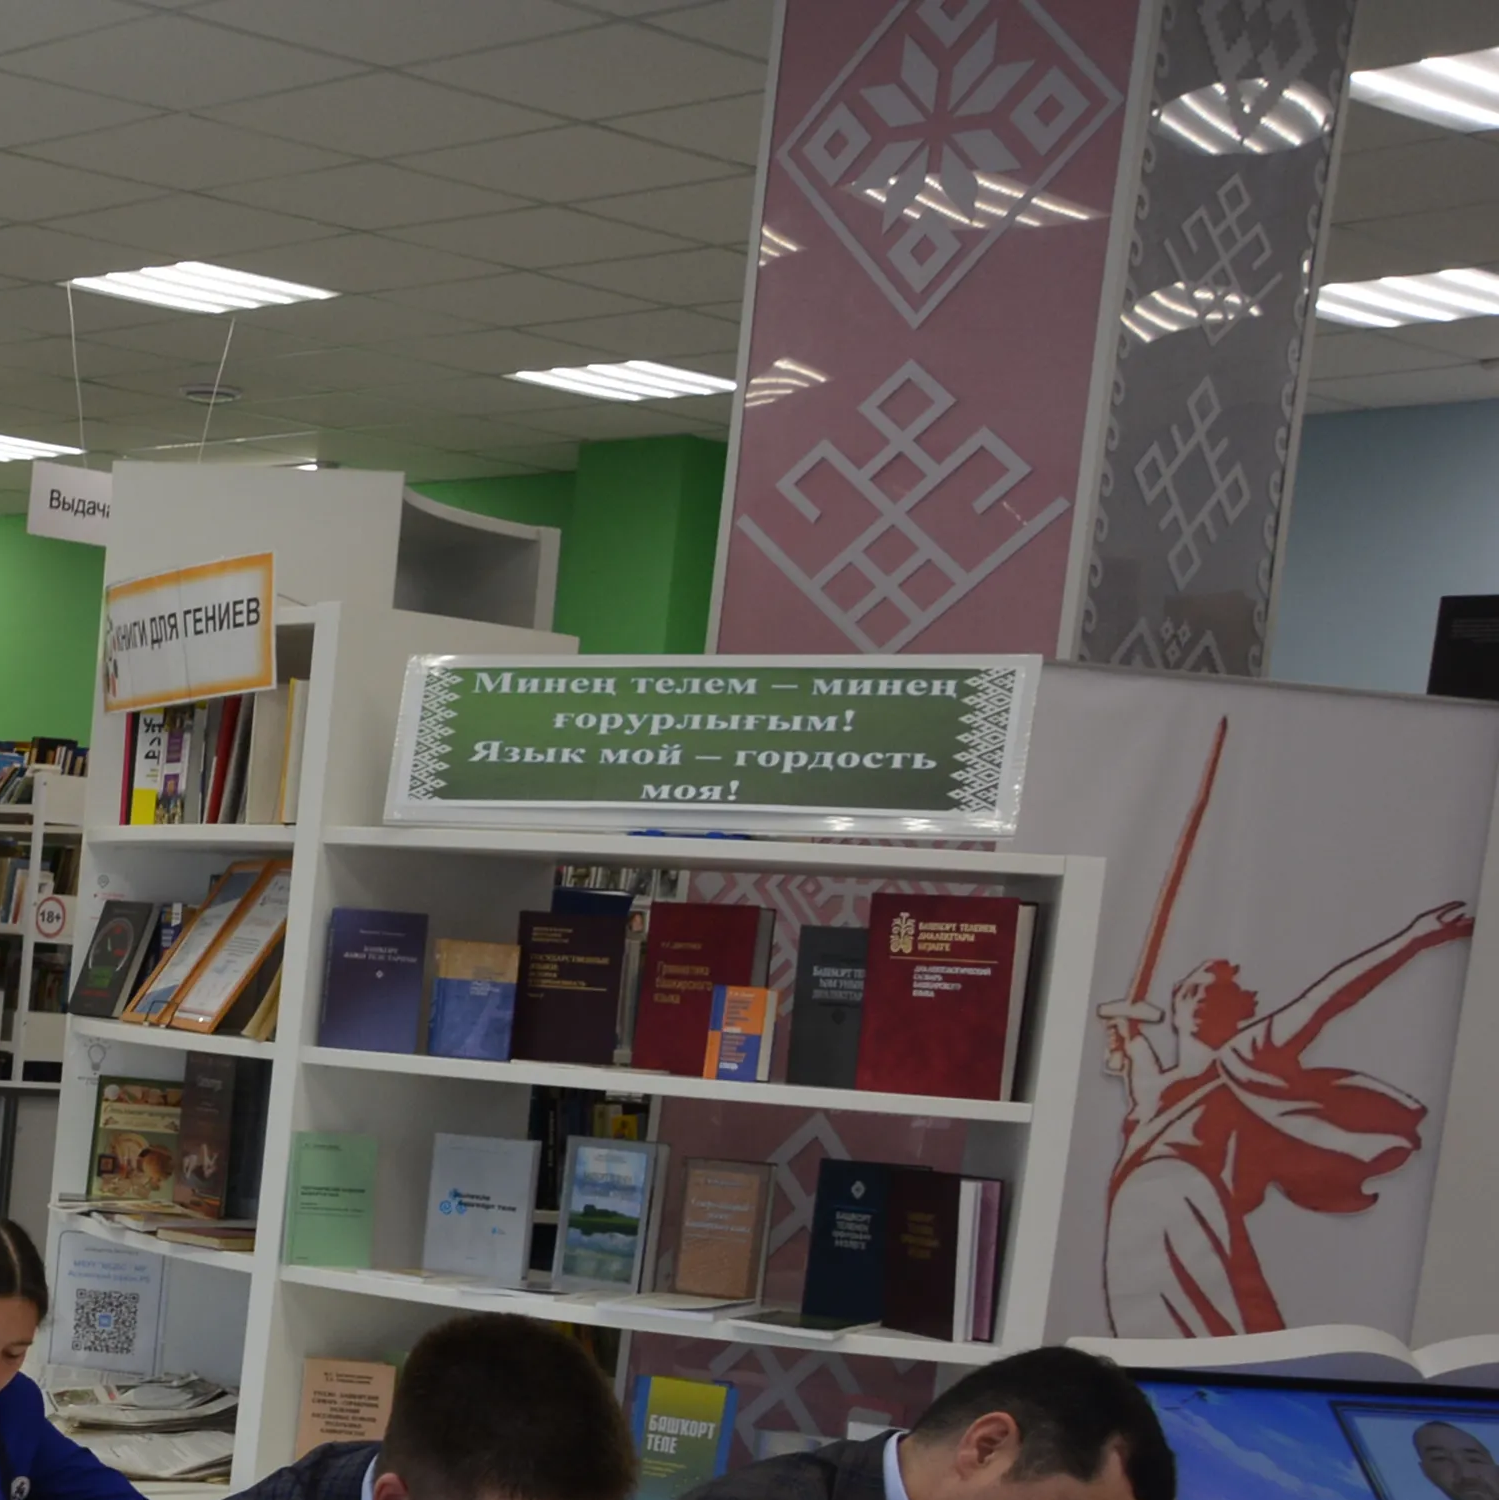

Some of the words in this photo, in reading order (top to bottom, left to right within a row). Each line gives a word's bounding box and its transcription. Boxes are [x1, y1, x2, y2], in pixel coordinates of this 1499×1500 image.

[115, 619, 149, 653] КНИГИ
[150, 612, 180, 650] ДЛЯ
[183, 597, 261, 638] ГЕНИЕВ
[473, 671, 619, 698] Минең
[631, 674, 758, 696] телем
[811, 674, 960, 700] минең
[552, 708, 855, 736] ғорурлығым!
[467, 740, 586, 765] Язык
[599, 741, 683, 766] мой
[734, 746, 938, 773] гордость
[640, 778, 739, 802] моя!
[39, 911, 62, 924] 18+
[646, 1434, 678, 1454] ТЕЛЕ
